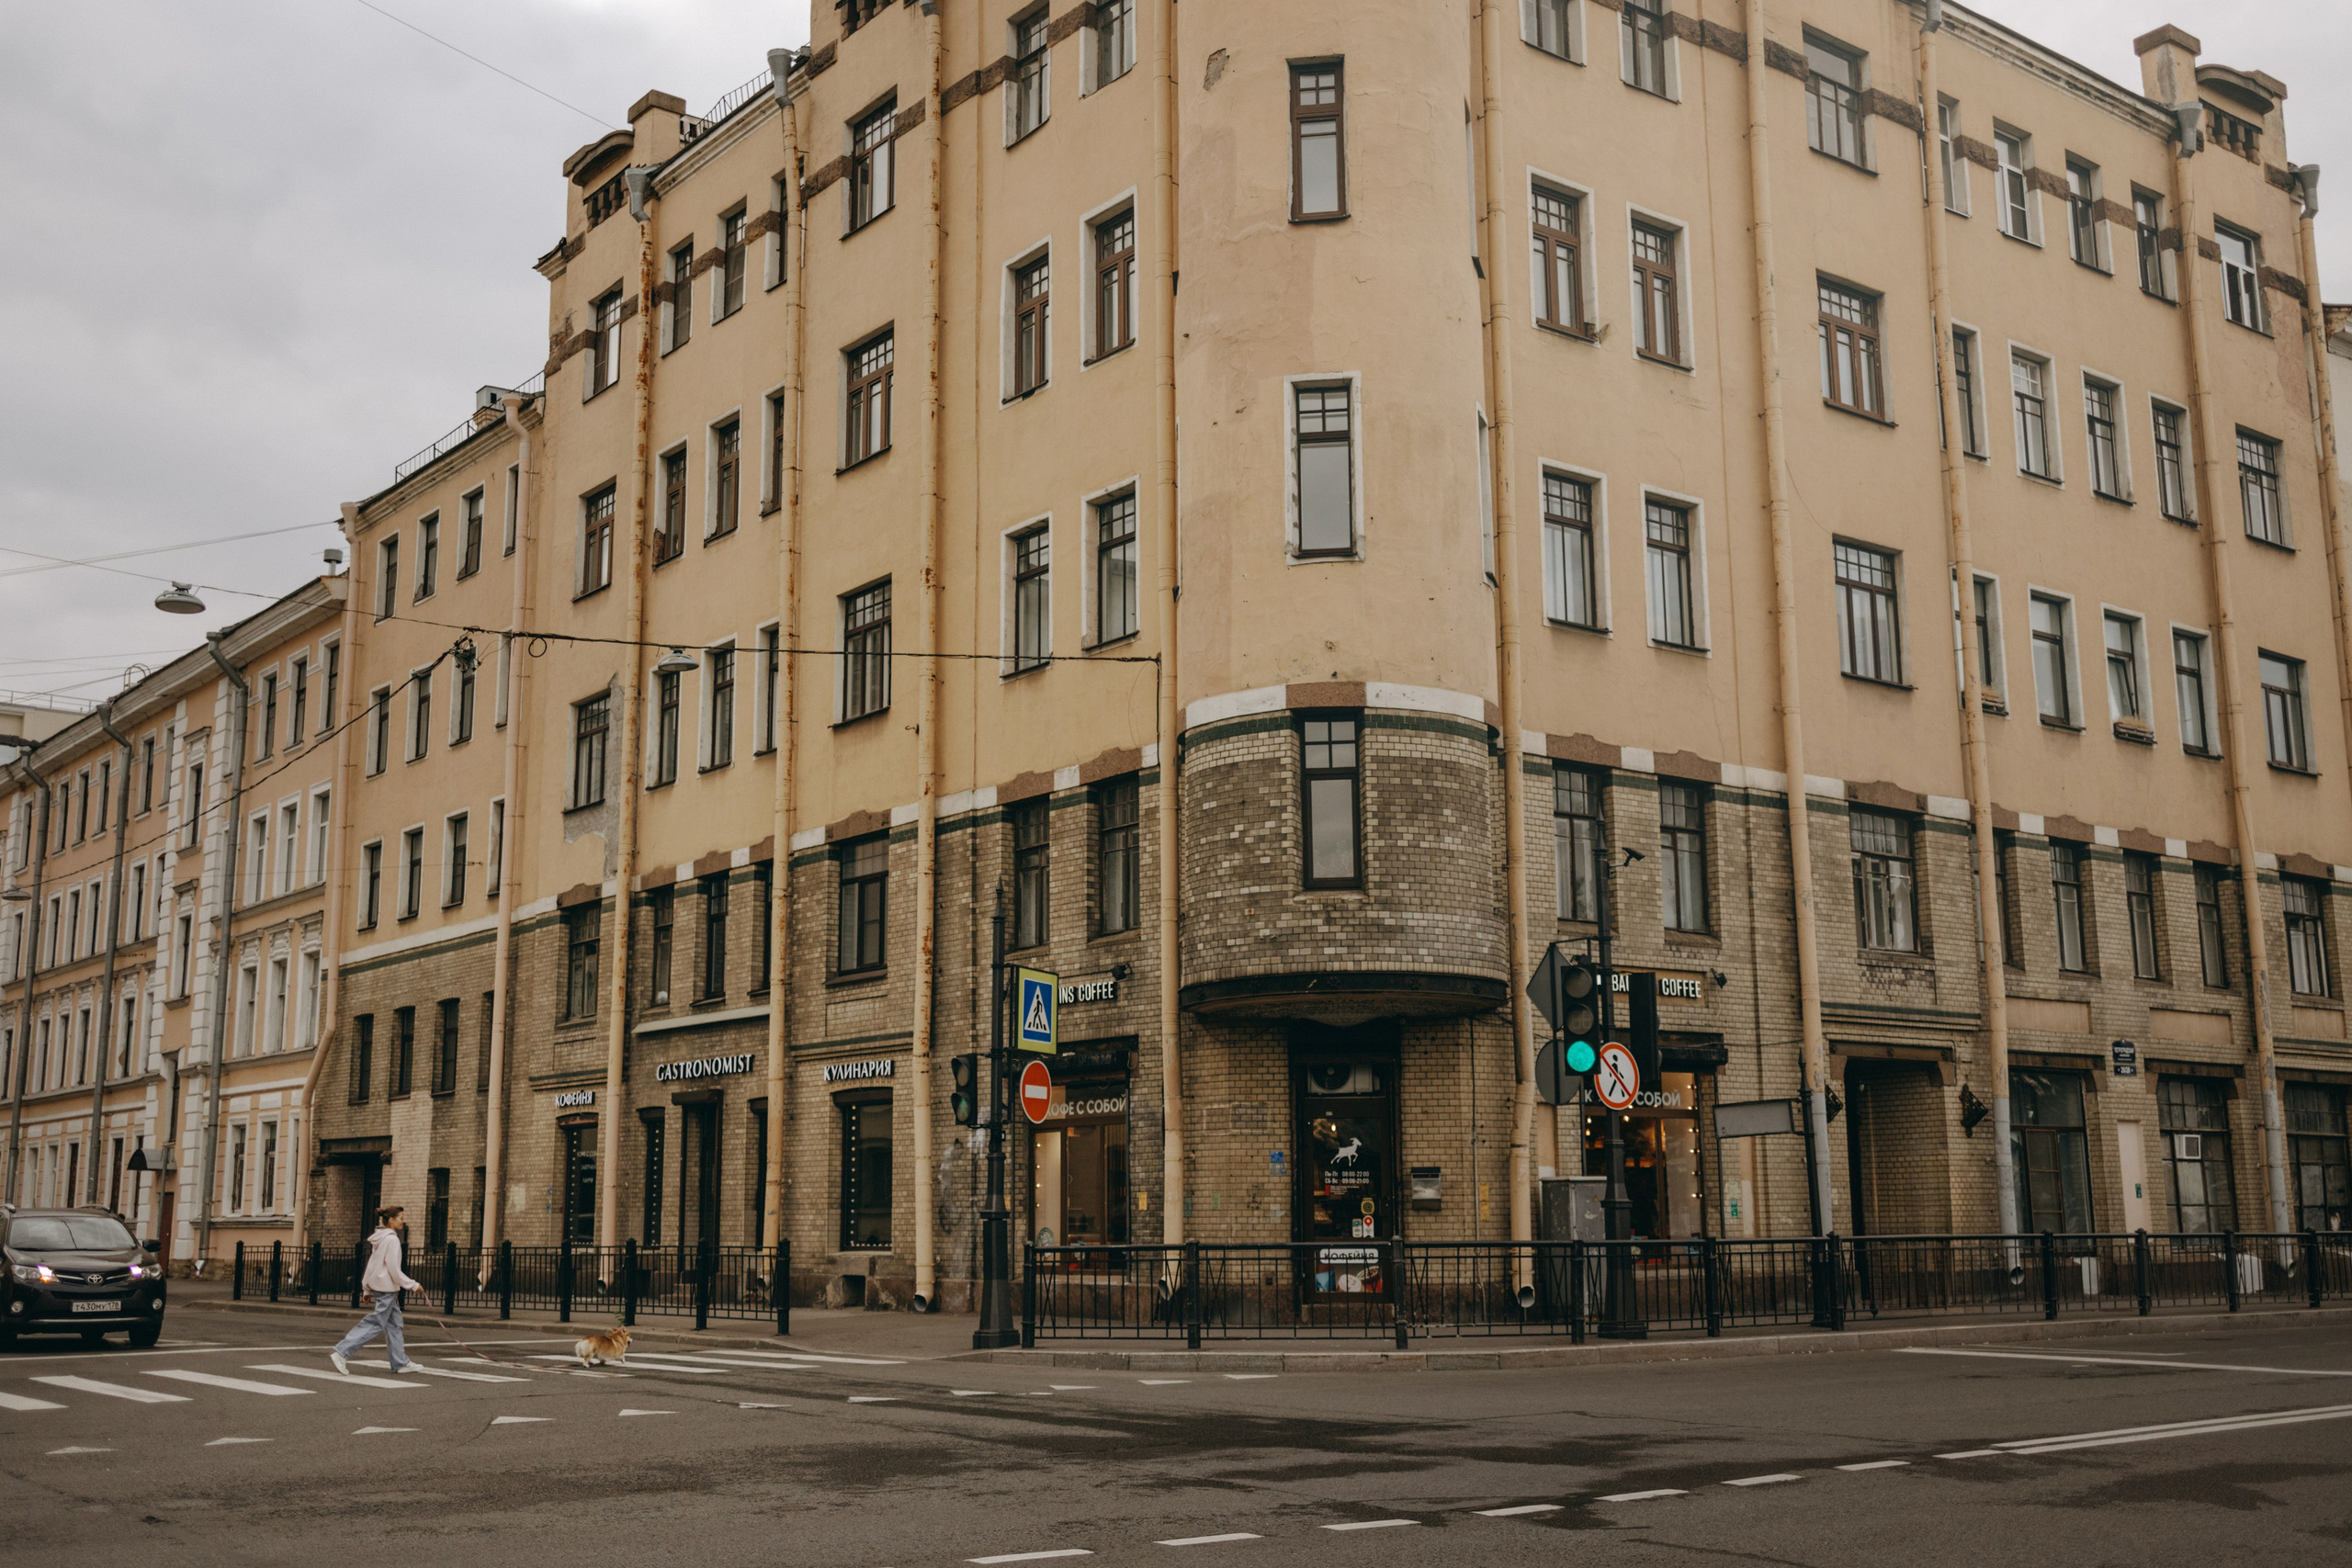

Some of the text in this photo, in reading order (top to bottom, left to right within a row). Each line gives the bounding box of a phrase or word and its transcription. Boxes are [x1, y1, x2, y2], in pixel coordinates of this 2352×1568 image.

[1058, 981, 1114, 1004] INS COFFEE
[1661, 977, 1702, 998] COFFEE
[656, 1054, 752, 1082] GASTRONOMIST
[823, 1059, 892, 1082] КУЛИНАРИЯ
[555, 1089, 594, 1108] КОФЕЙНЯ
[1076, 1100, 1085, 1115] С
[1086, 1093, 1126, 1115] СОБОЙ
[1634, 1089, 1681, 1107] СОБОЙ
